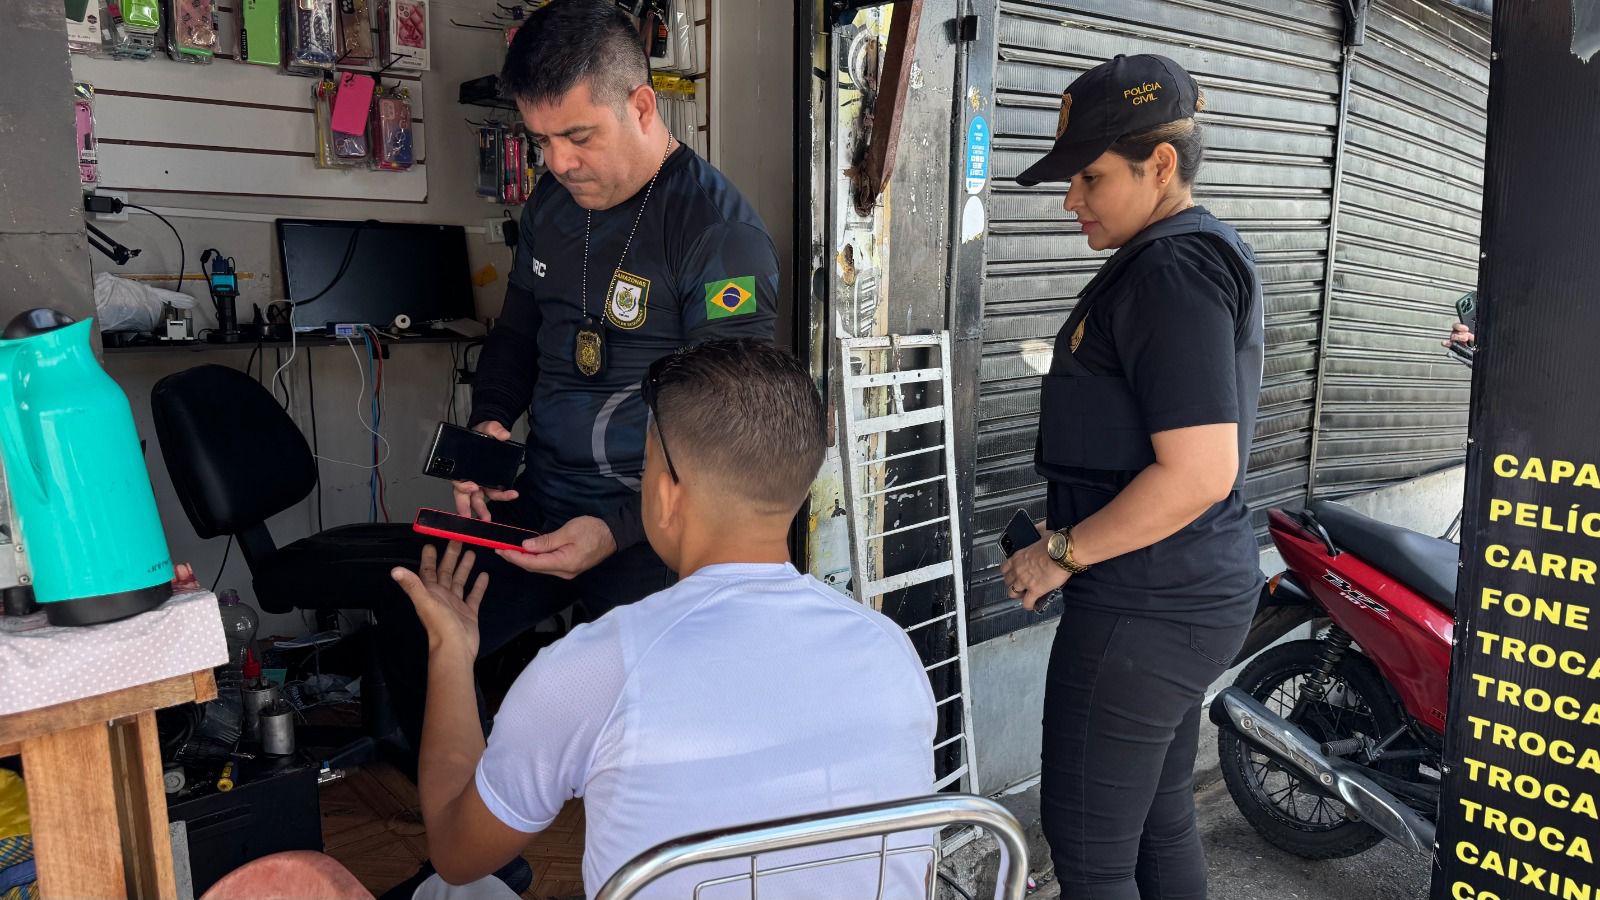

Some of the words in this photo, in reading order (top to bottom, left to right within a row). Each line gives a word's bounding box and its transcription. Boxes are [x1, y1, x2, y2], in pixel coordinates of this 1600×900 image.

[1123, 81, 1162, 99] POLÍCIA
[1132, 93, 1158, 106] CIVIL
[616, 272, 647, 288] AMAZONAS
[1493, 454, 1600, 489] CAPA
[1489, 498, 1600, 538] PELÍC
[1484, 544, 1598, 585] CARR
[1481, 587, 1590, 631] FONE
[1472, 673, 1600, 726] TROCA
[1467, 715, 1600, 774] TROCA
[1463, 757, 1599, 820] TROCA
[1459, 798, 1594, 864] TROCA
[1455, 841, 1600, 900] CAIXIN
